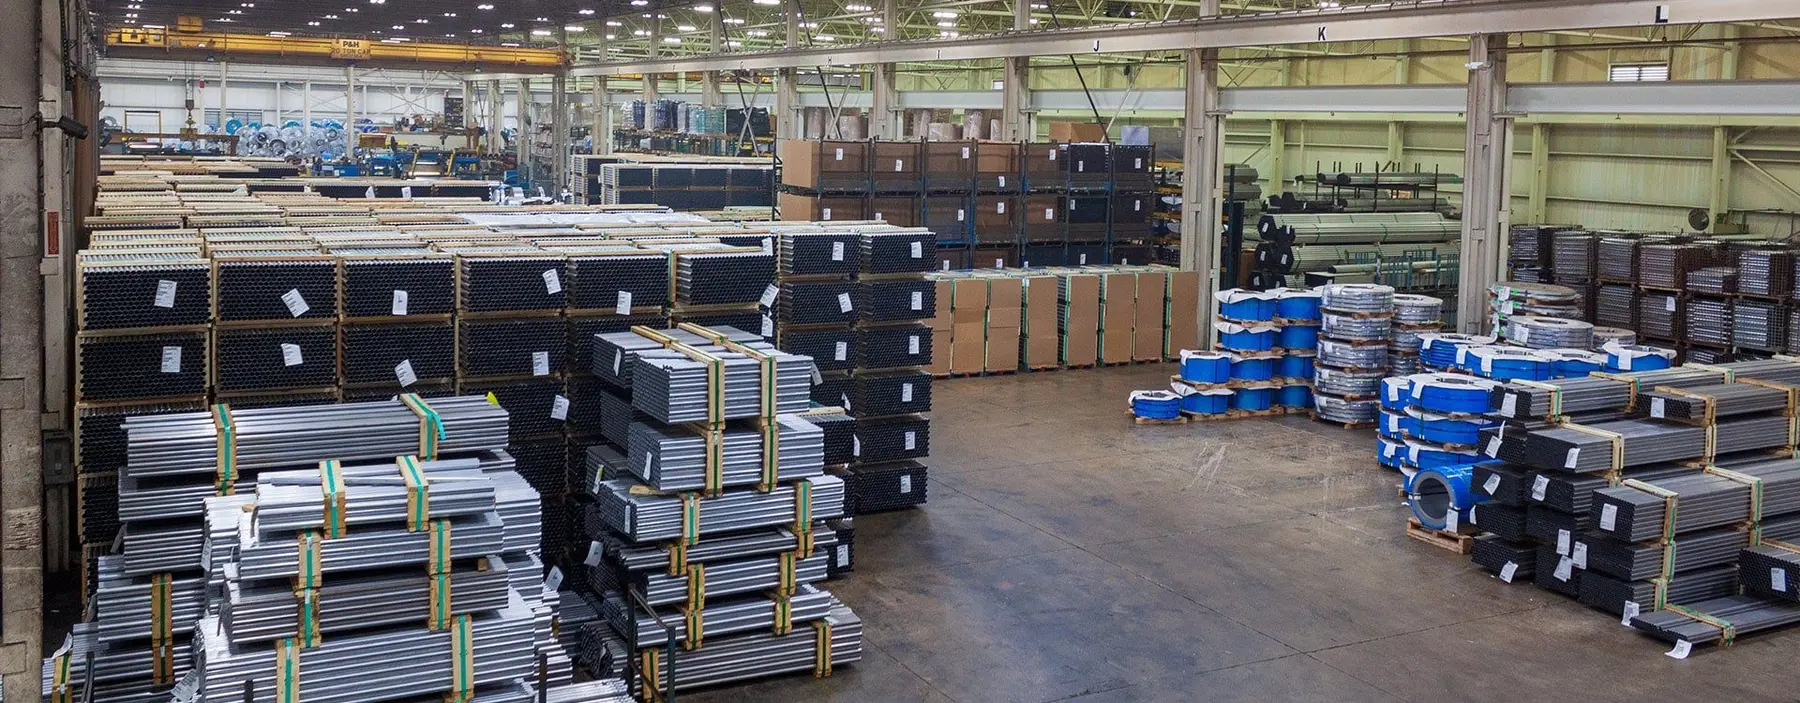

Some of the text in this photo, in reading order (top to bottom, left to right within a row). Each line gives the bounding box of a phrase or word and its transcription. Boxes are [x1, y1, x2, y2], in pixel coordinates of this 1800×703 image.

[1655, 5, 1668, 23] L
[1318, 26, 1326, 41] K
[342, 40, 360, 48] P&H
[1093, 40, 1100, 52] J
